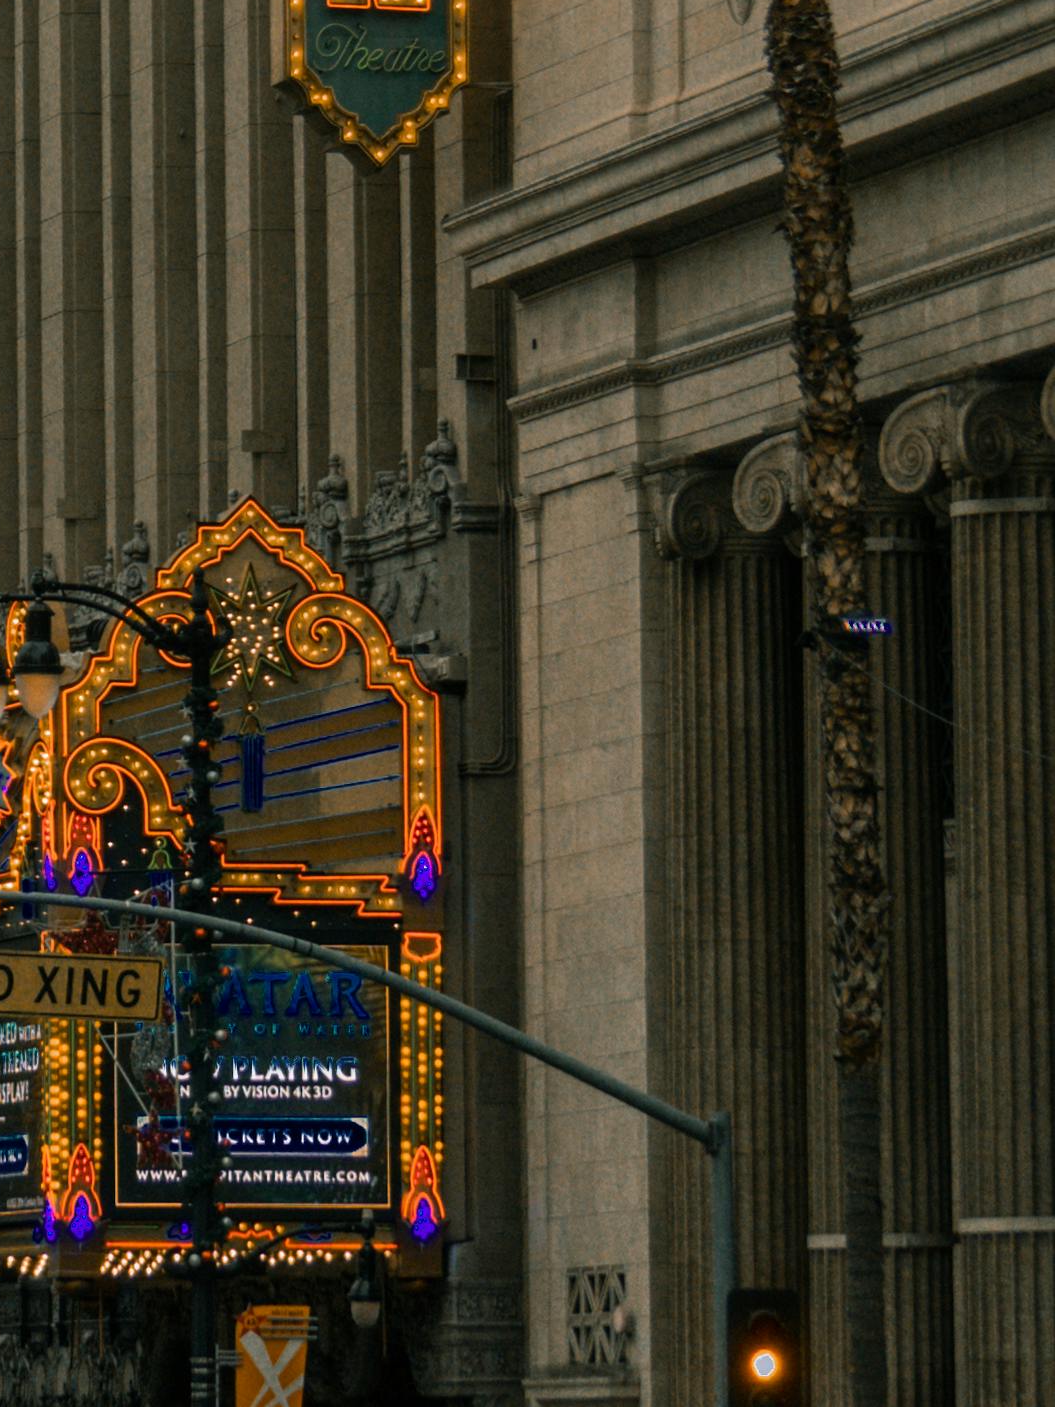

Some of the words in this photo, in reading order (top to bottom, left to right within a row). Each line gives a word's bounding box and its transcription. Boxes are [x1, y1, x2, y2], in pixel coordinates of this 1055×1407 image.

[313, 22, 451, 76] Theatre
[33, 965, 141, 1009] XING
[2, 1047, 40, 1073] THEMED
[231, 1054, 358, 1083] PLAYING
[242, 1084, 290, 1100] VISION
[217, 1128, 292, 1145] ICKETS
[300, 1128, 353, 1145] NOW
